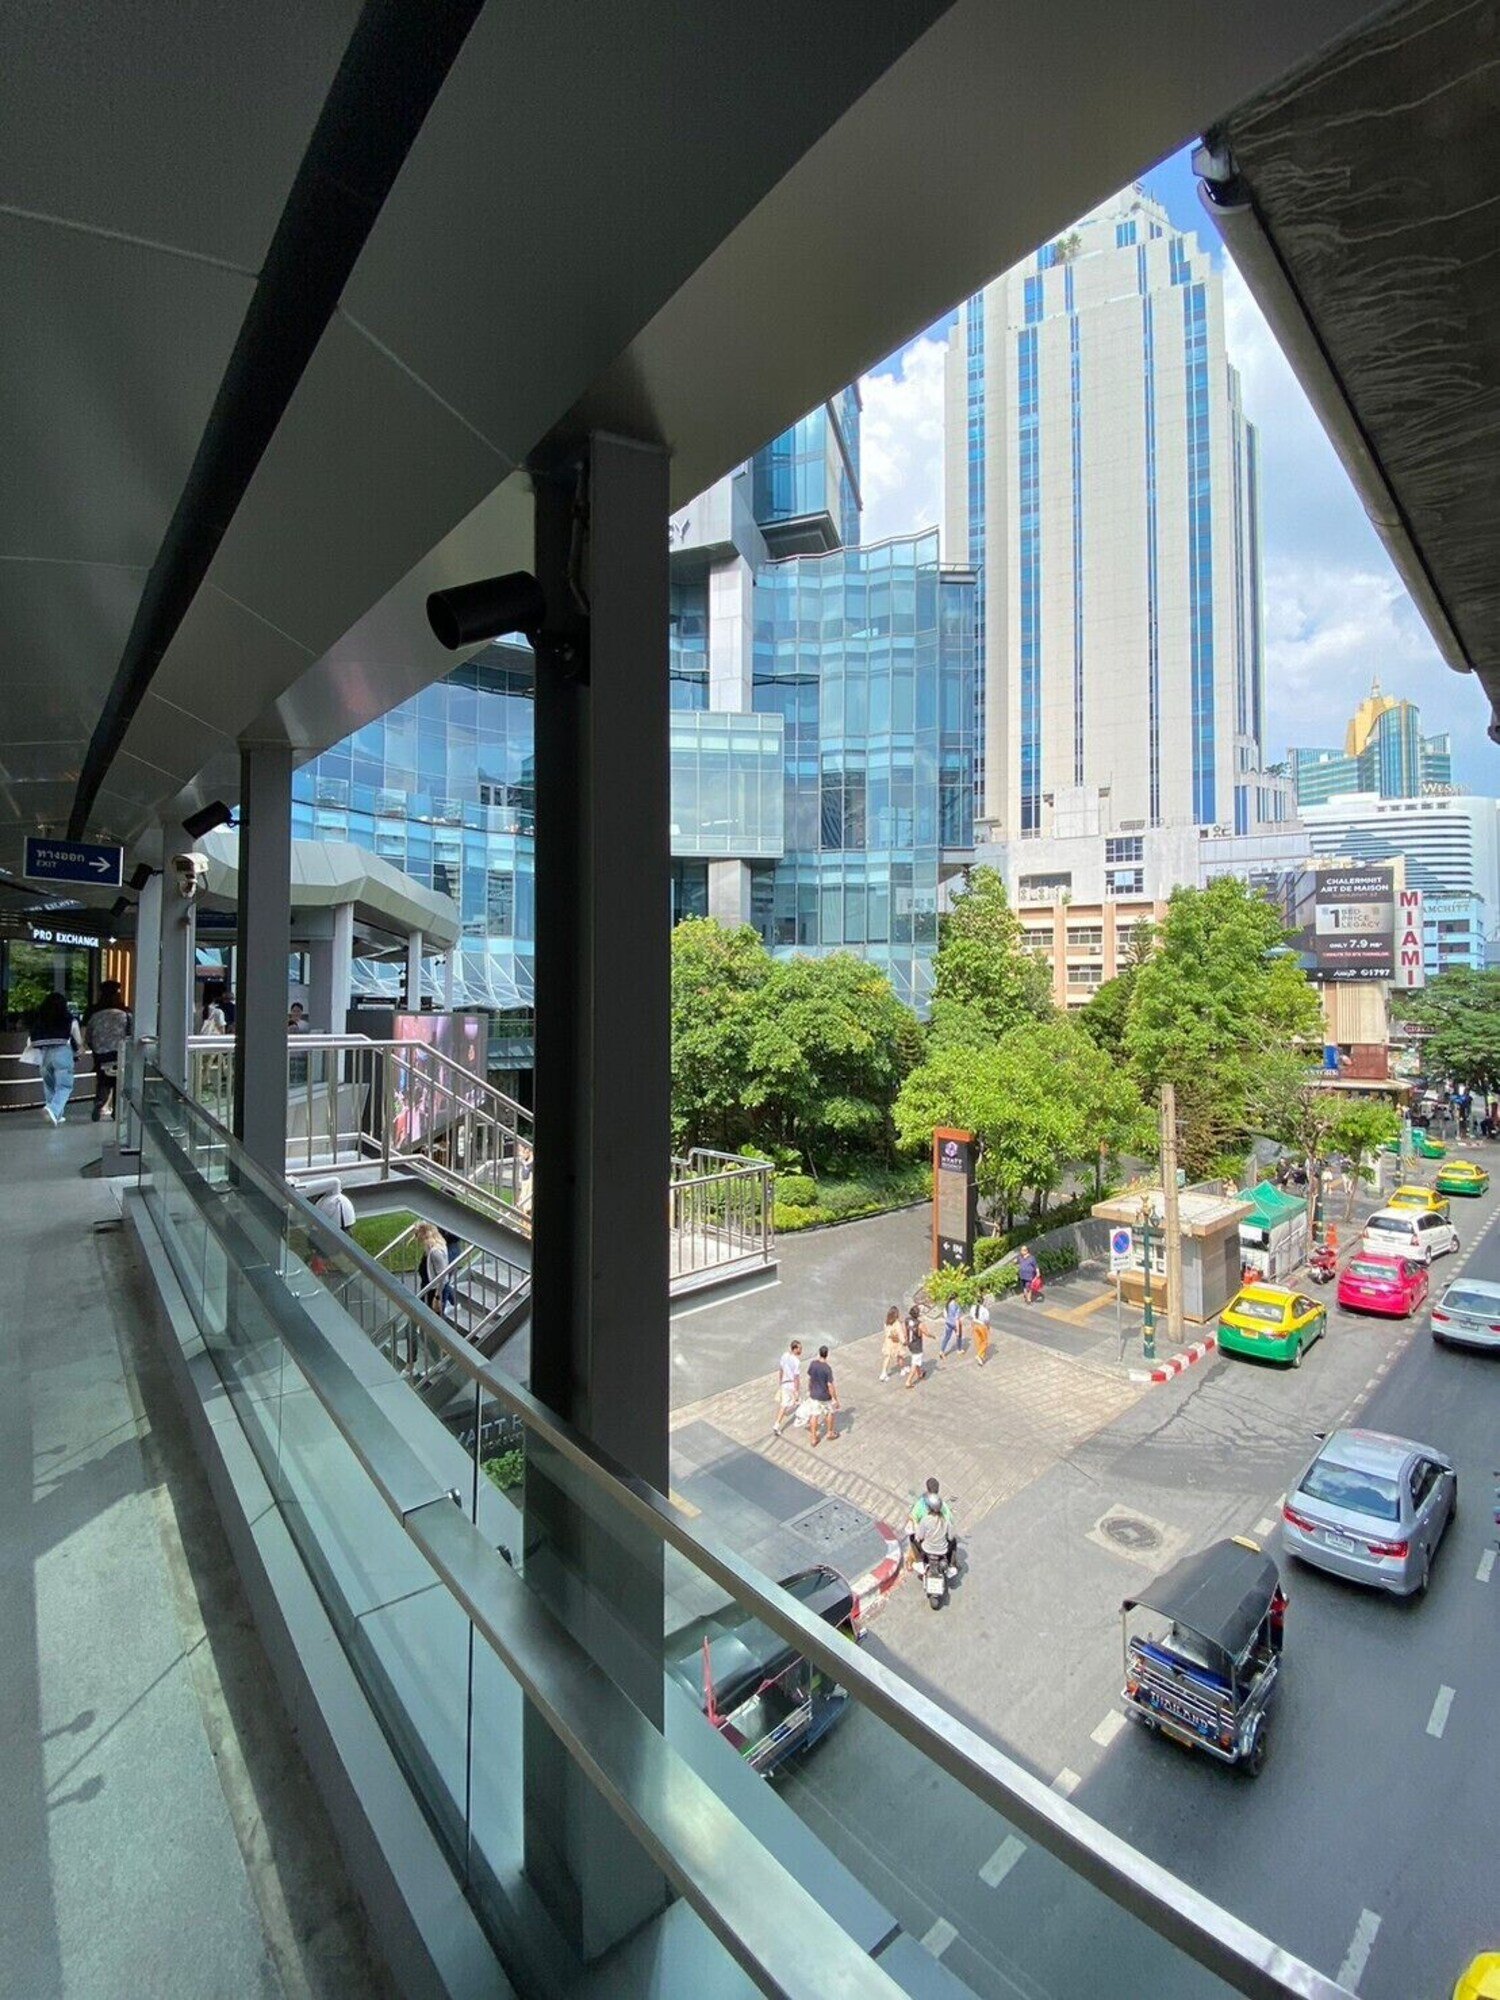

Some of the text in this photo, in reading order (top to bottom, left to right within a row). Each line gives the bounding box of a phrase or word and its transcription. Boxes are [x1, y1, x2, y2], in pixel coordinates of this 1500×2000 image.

[35, 859, 57, 868] EXIT
[1353, 883, 1389, 892] MAISON
[1330, 909, 1340, 928] 1
[33, 929, 99, 948] PRO EXCHANGE
[1349, 939, 1368, 949] 7.9
[1399, 891, 1421, 986] MIAMI
